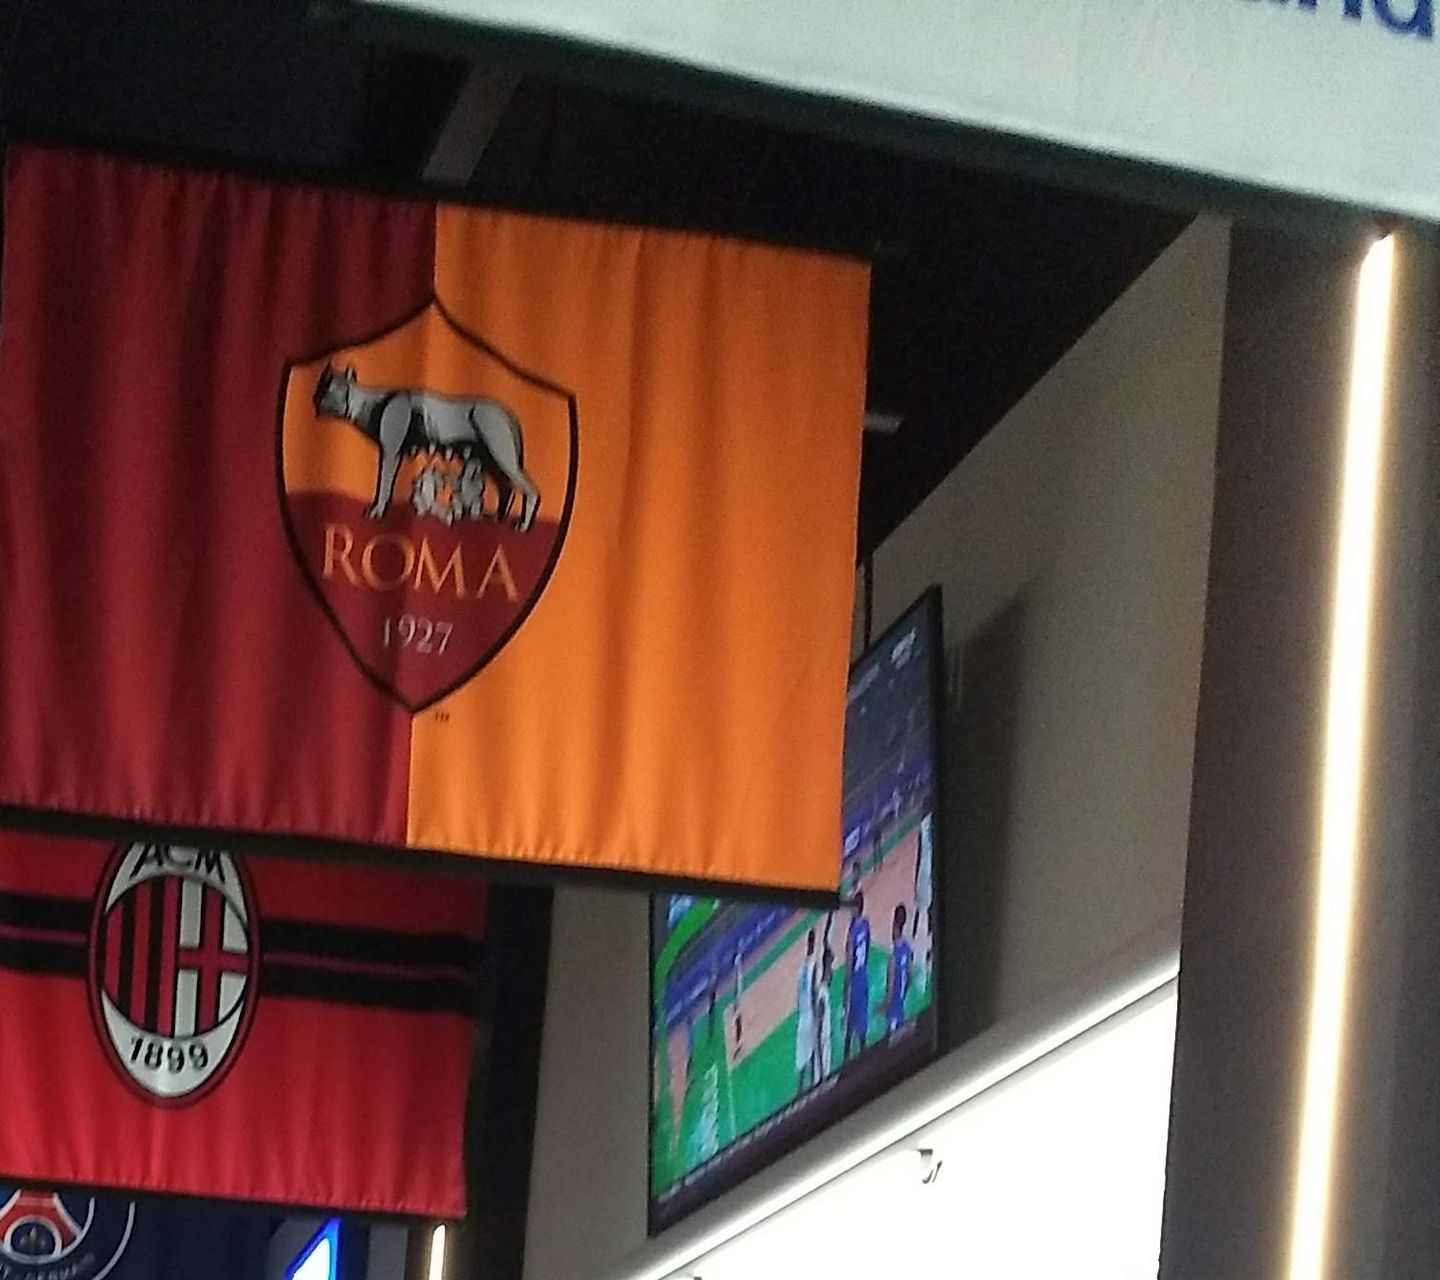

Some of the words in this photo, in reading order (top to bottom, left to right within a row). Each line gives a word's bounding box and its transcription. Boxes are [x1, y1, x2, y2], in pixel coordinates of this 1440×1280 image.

[323, 523, 518, 600] ROMA
[384, 614, 453, 656] 1927
[131, 1037, 208, 1075] 1899
